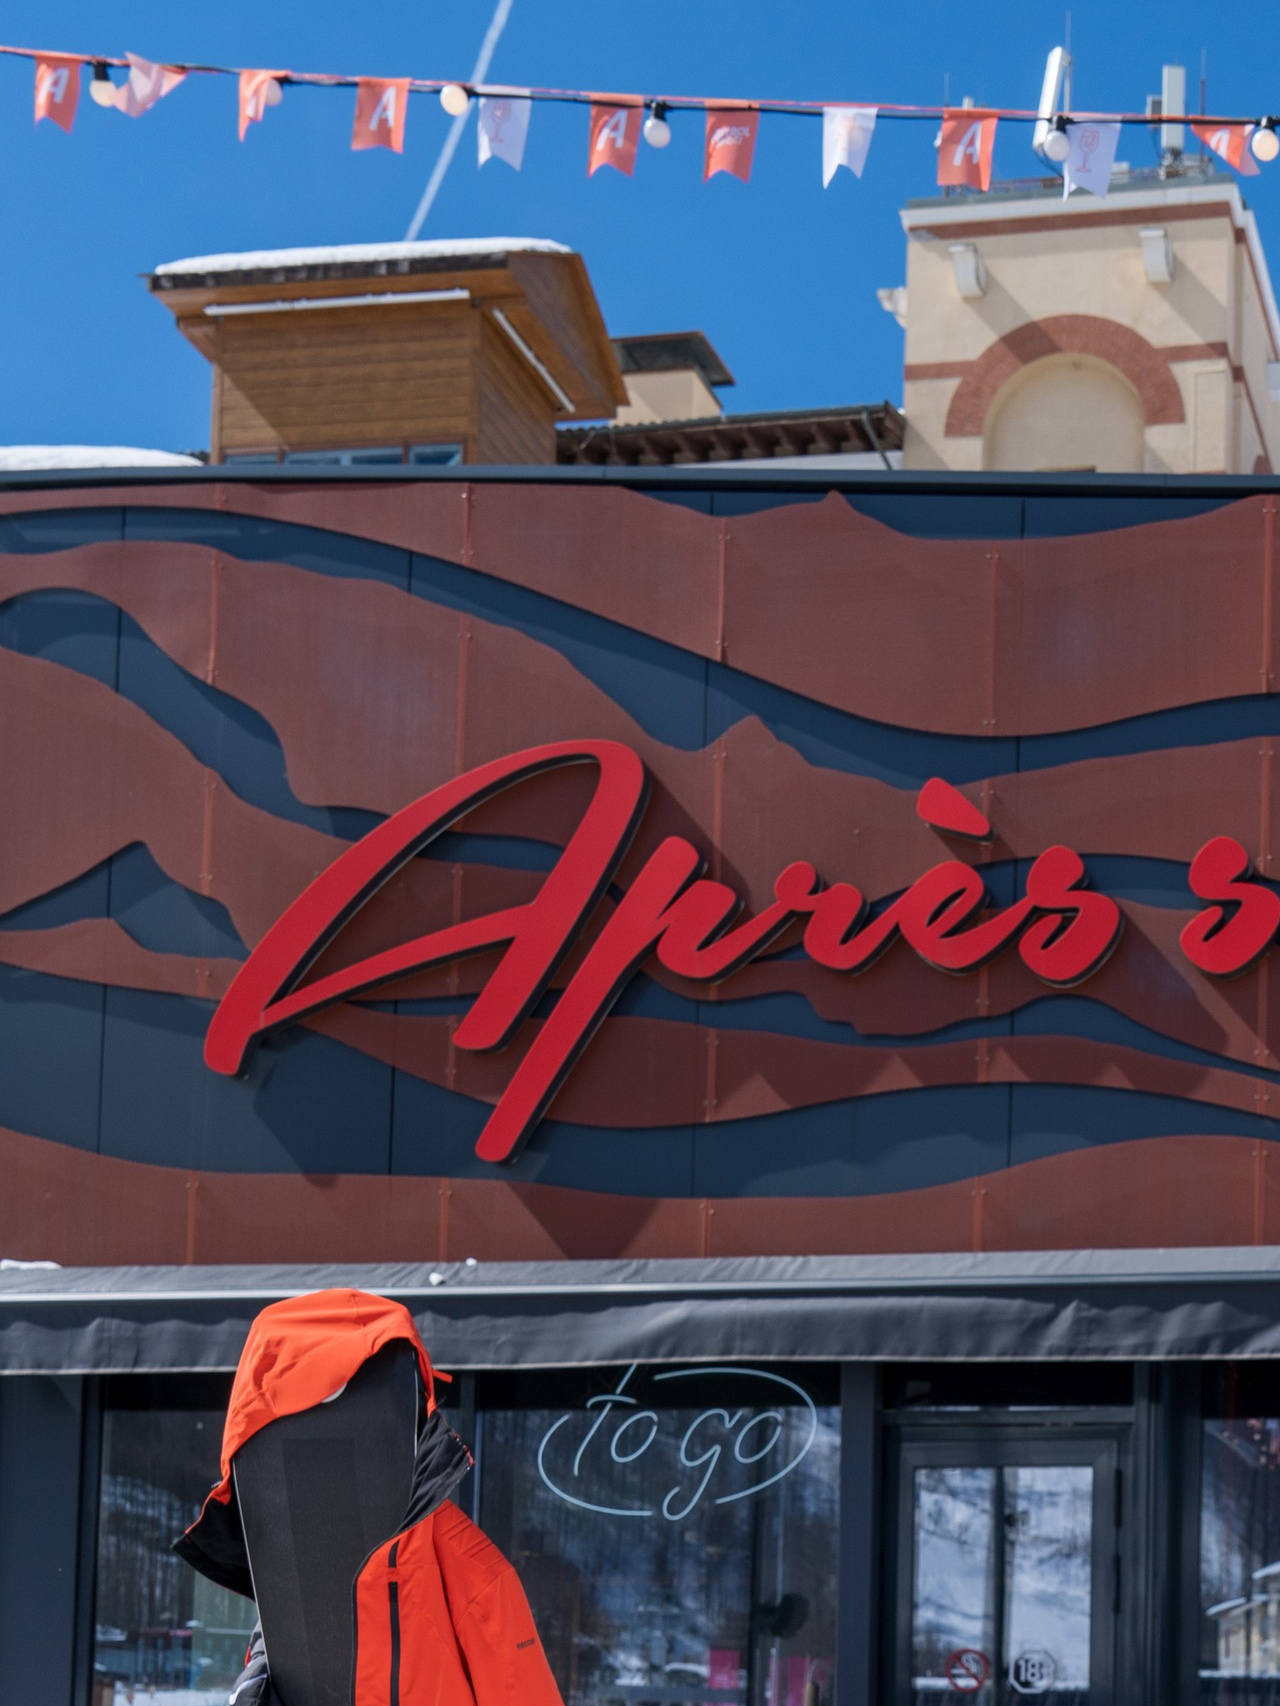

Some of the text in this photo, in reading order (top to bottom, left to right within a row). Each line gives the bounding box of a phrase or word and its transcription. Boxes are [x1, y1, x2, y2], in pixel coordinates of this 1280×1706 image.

[205, 738, 1124, 1164] Après
[573, 1362, 783, 1521] To go
